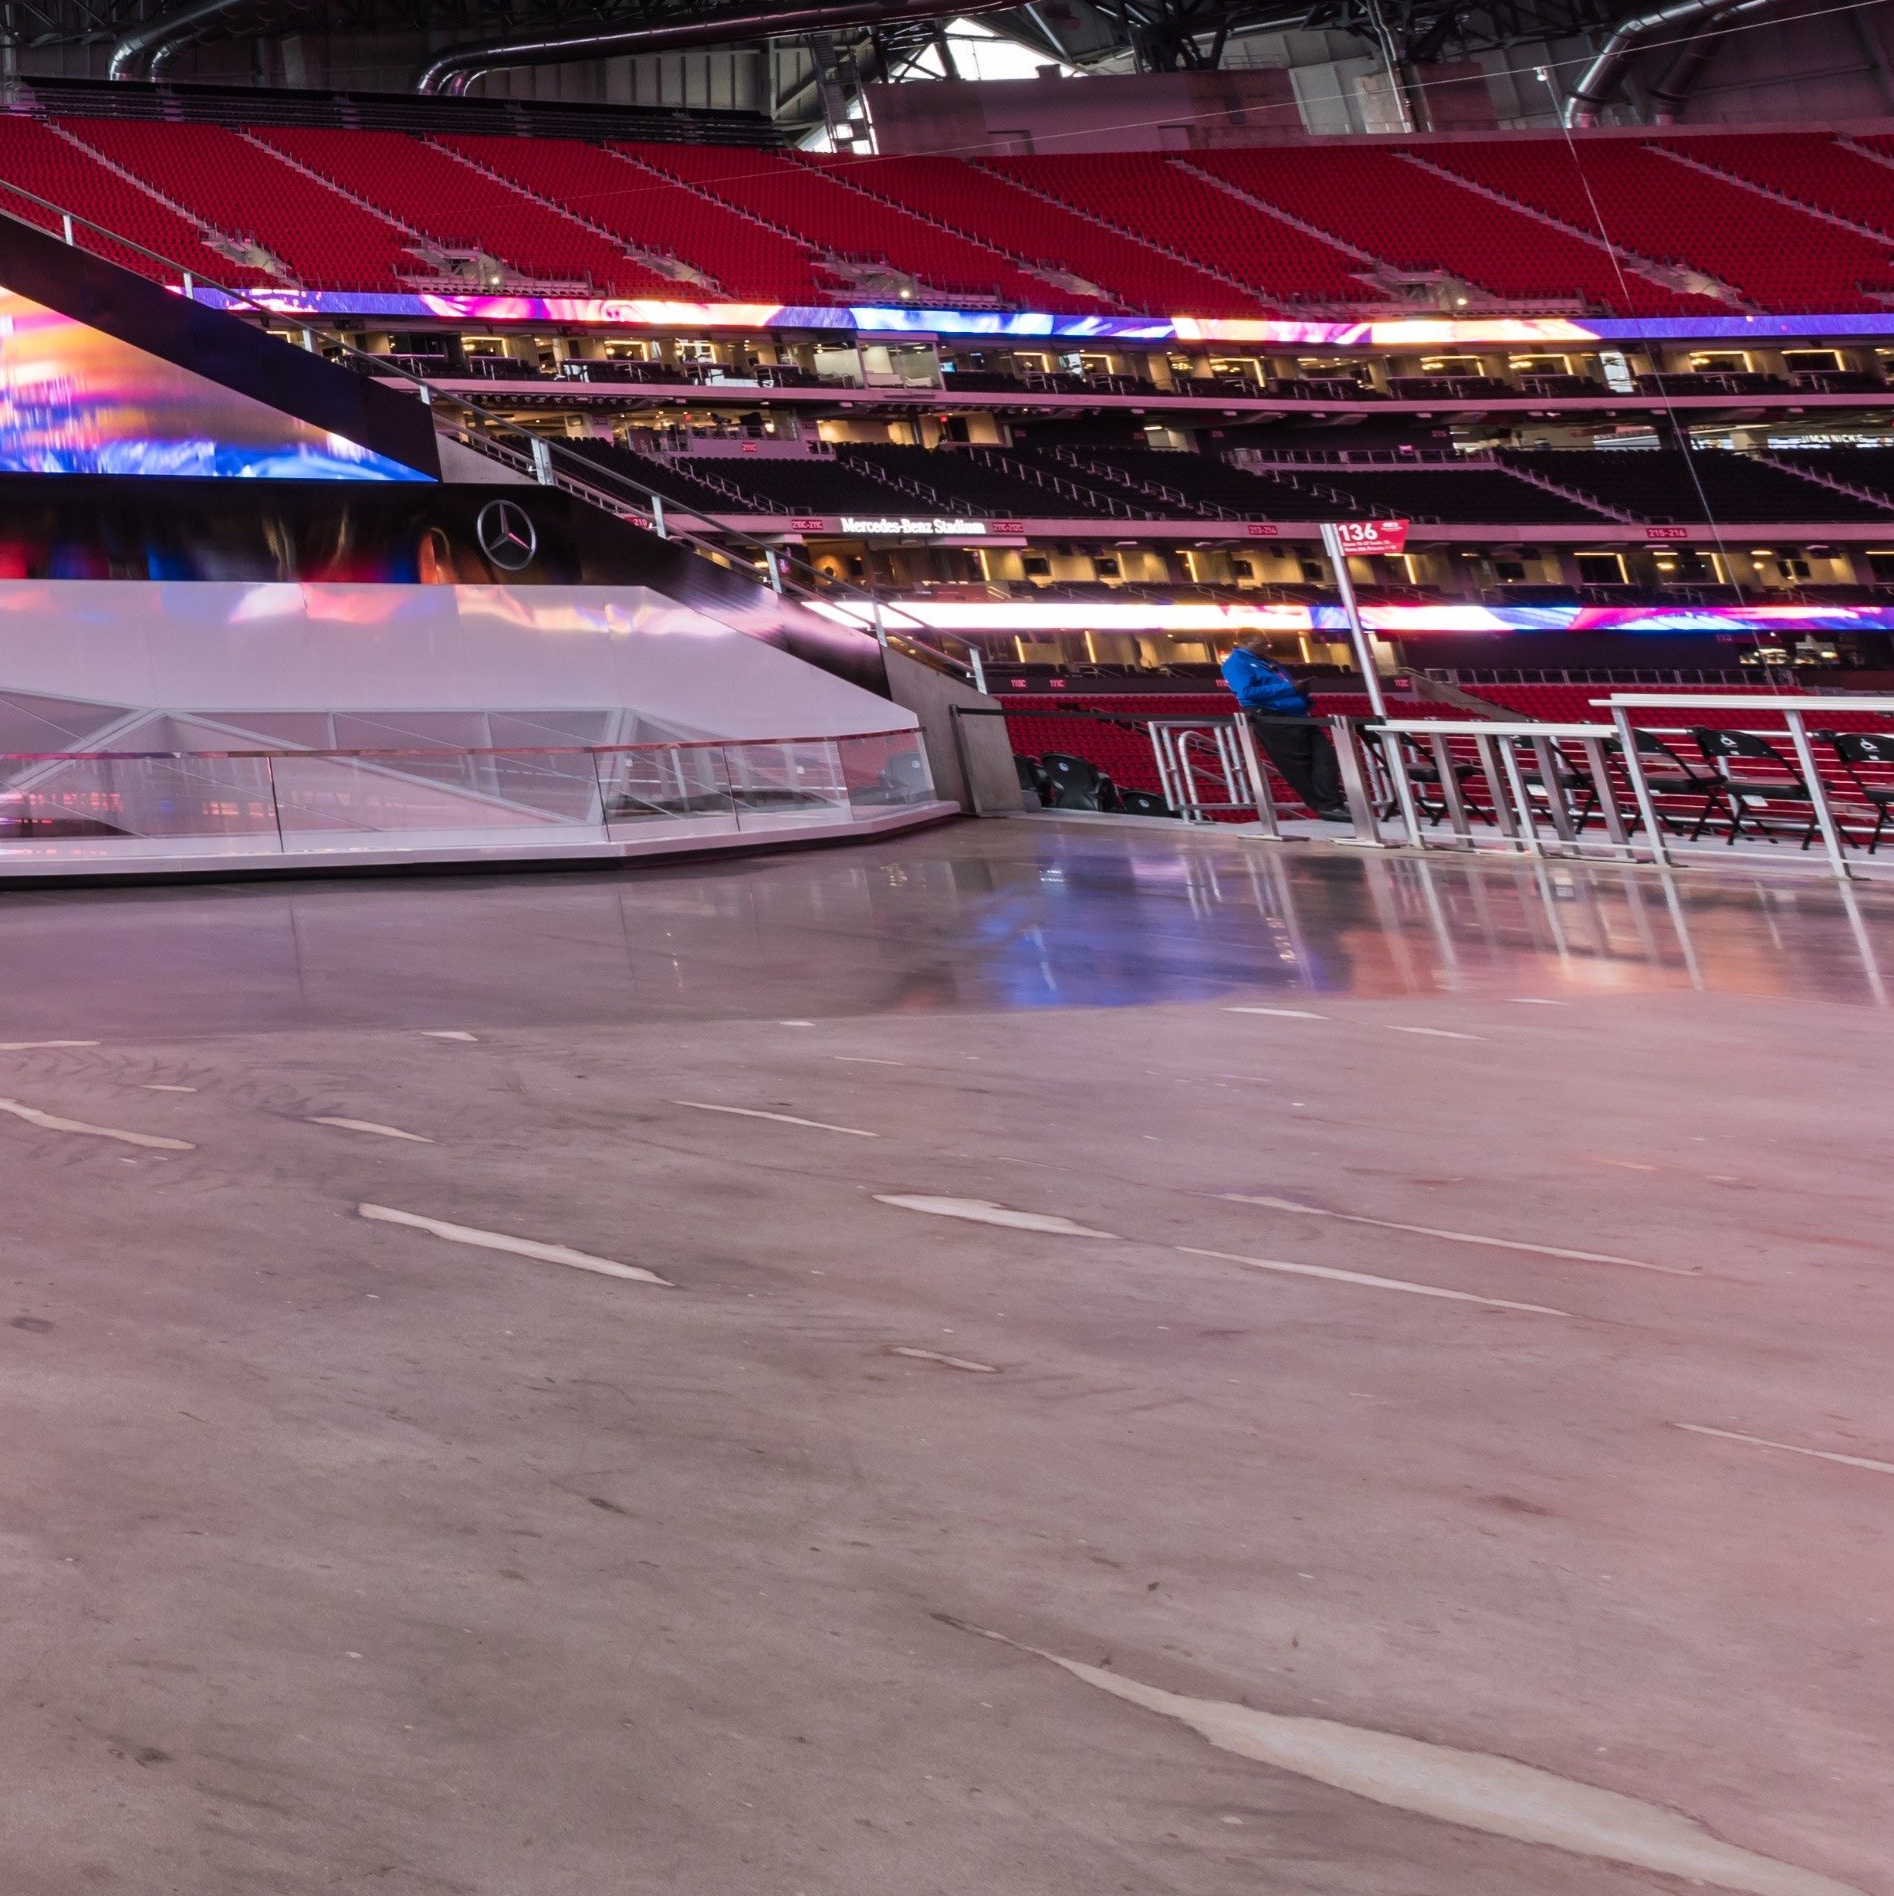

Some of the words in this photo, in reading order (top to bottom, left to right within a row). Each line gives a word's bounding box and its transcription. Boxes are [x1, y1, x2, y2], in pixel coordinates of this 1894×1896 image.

[634, 517, 647, 527] 210
[841, 518, 933, 534] Mercedes-Benz
[934, 519, 986, 534] Stadium
[1338, 522, 1378, 542] 136
